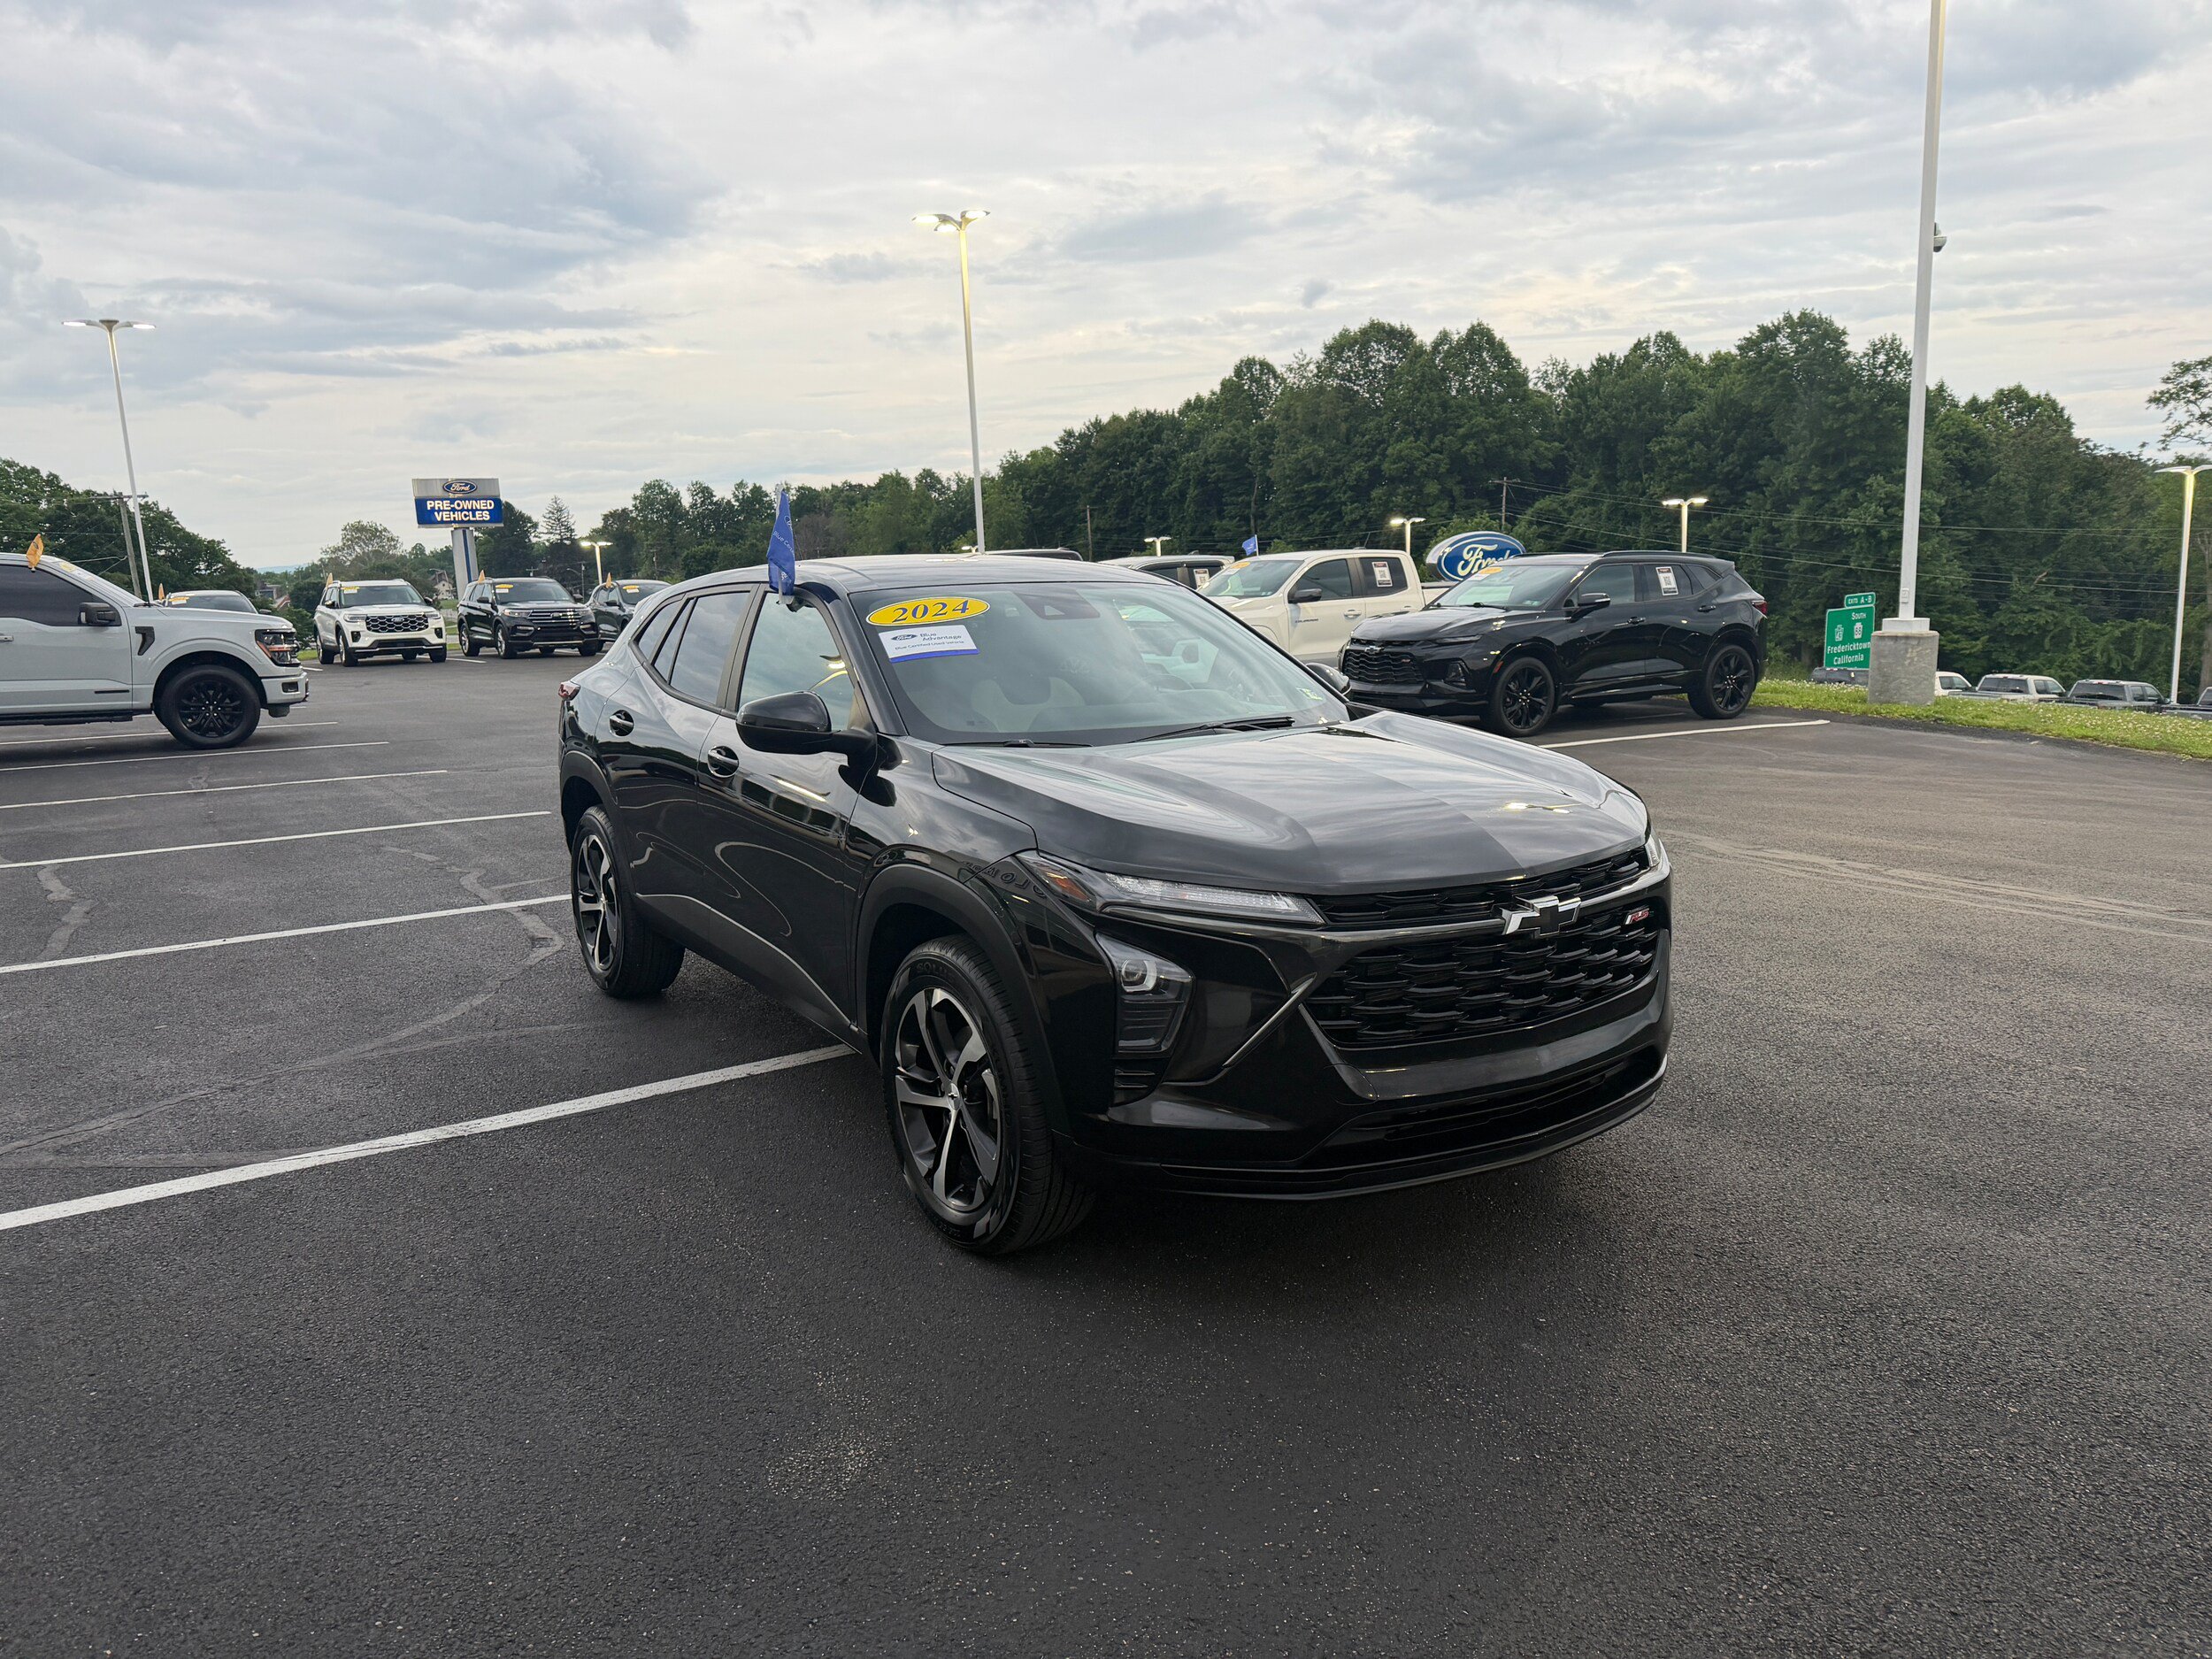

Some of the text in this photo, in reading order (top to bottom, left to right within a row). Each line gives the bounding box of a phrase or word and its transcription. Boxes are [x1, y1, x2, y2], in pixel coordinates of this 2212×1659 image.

[450, 482, 470, 491] Ford
[426, 500, 495, 511] PRE-OWNED
[434, 511, 490, 521] VEHICLES
[891, 599, 970, 623] 2024
[1827, 641, 1870, 654] Fredericktown
[1833, 653, 1864, 664] California
